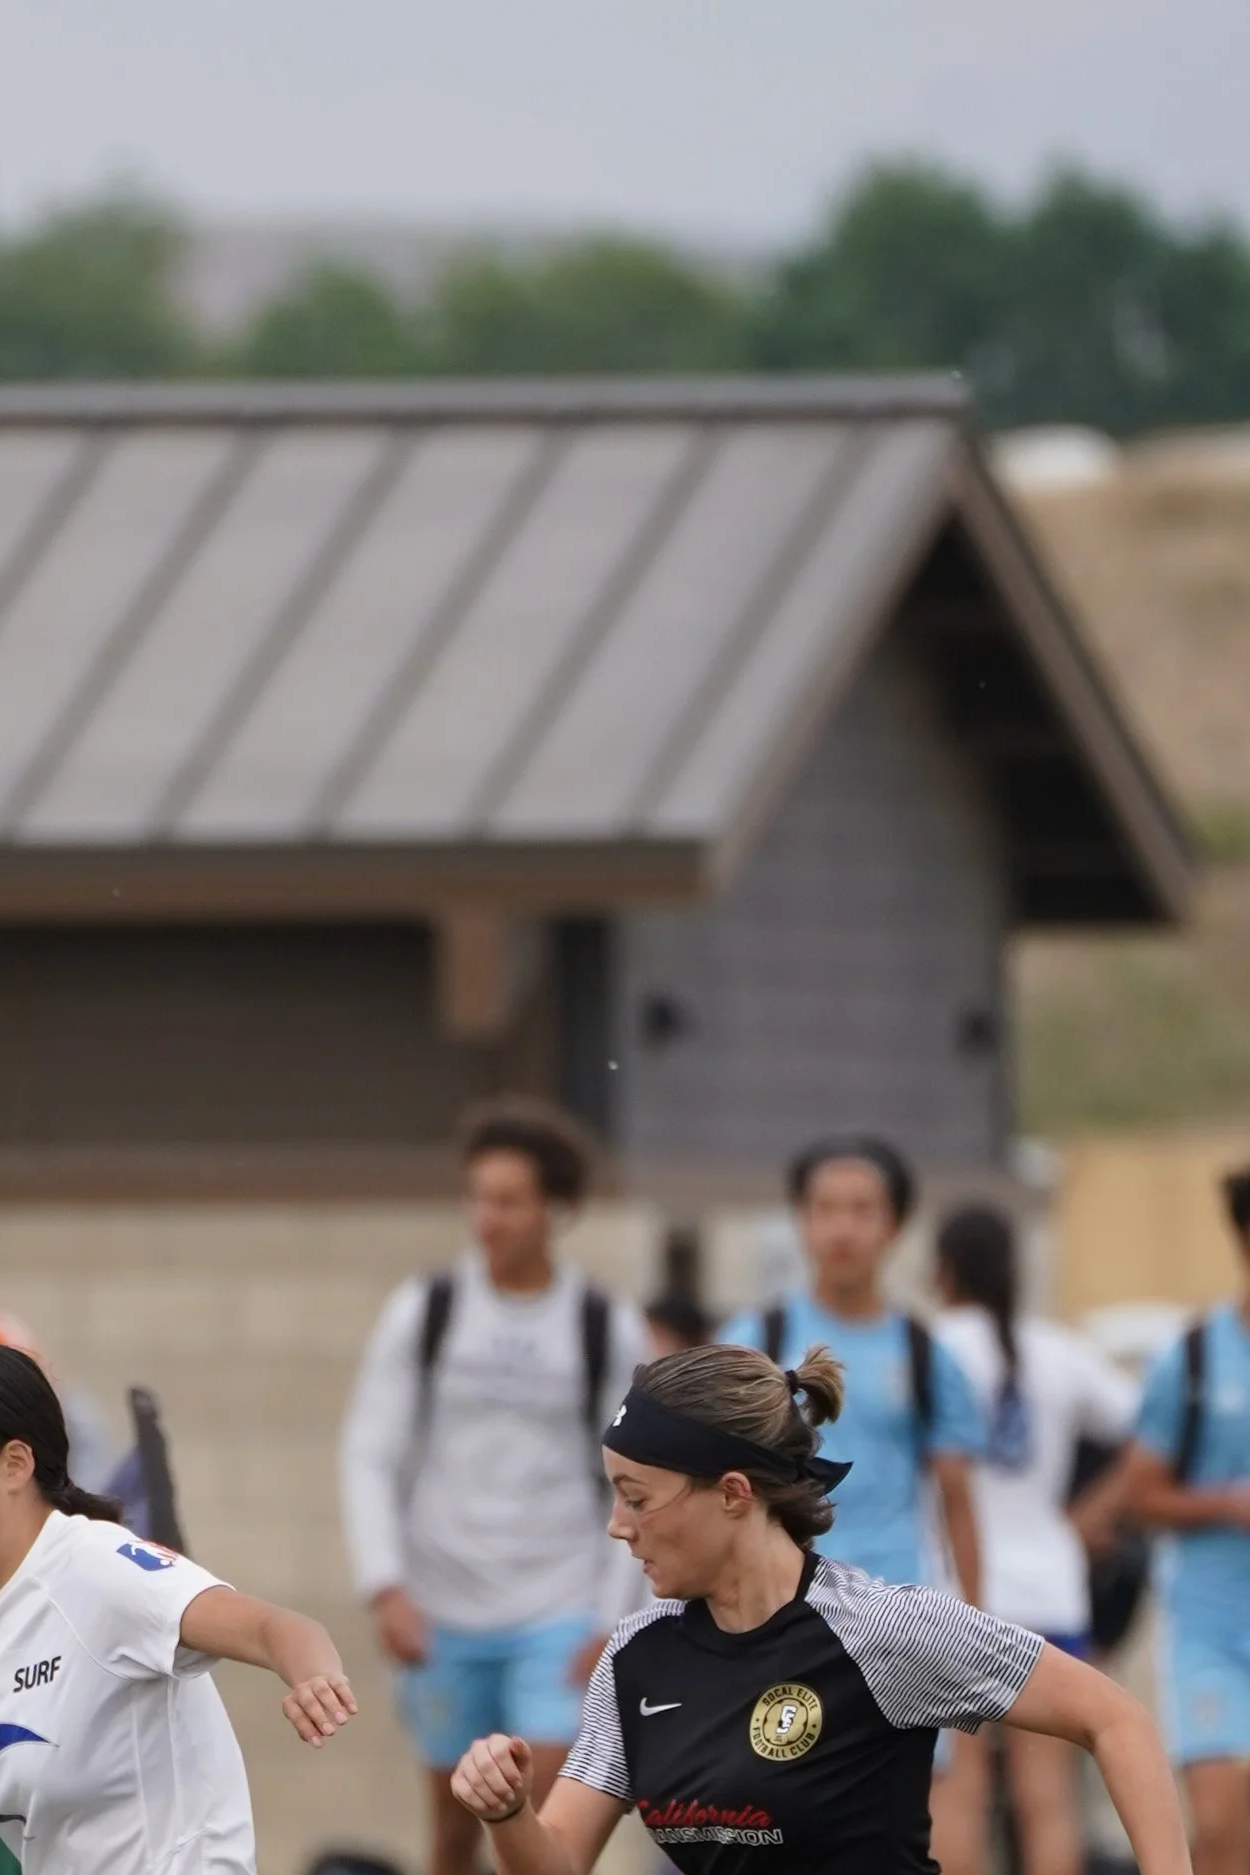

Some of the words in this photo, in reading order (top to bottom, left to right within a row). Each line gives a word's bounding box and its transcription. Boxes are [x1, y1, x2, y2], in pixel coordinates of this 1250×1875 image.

[13, 1655, 62, 1693] SURF
[762, 1686, 794, 1707] SOCAL
[796, 1686, 818, 1712] ELITE
[752, 1726, 788, 1758] FOOTBALL
[790, 1732, 816, 1756] CLUB
[637, 1798, 773, 1827] alifornia
